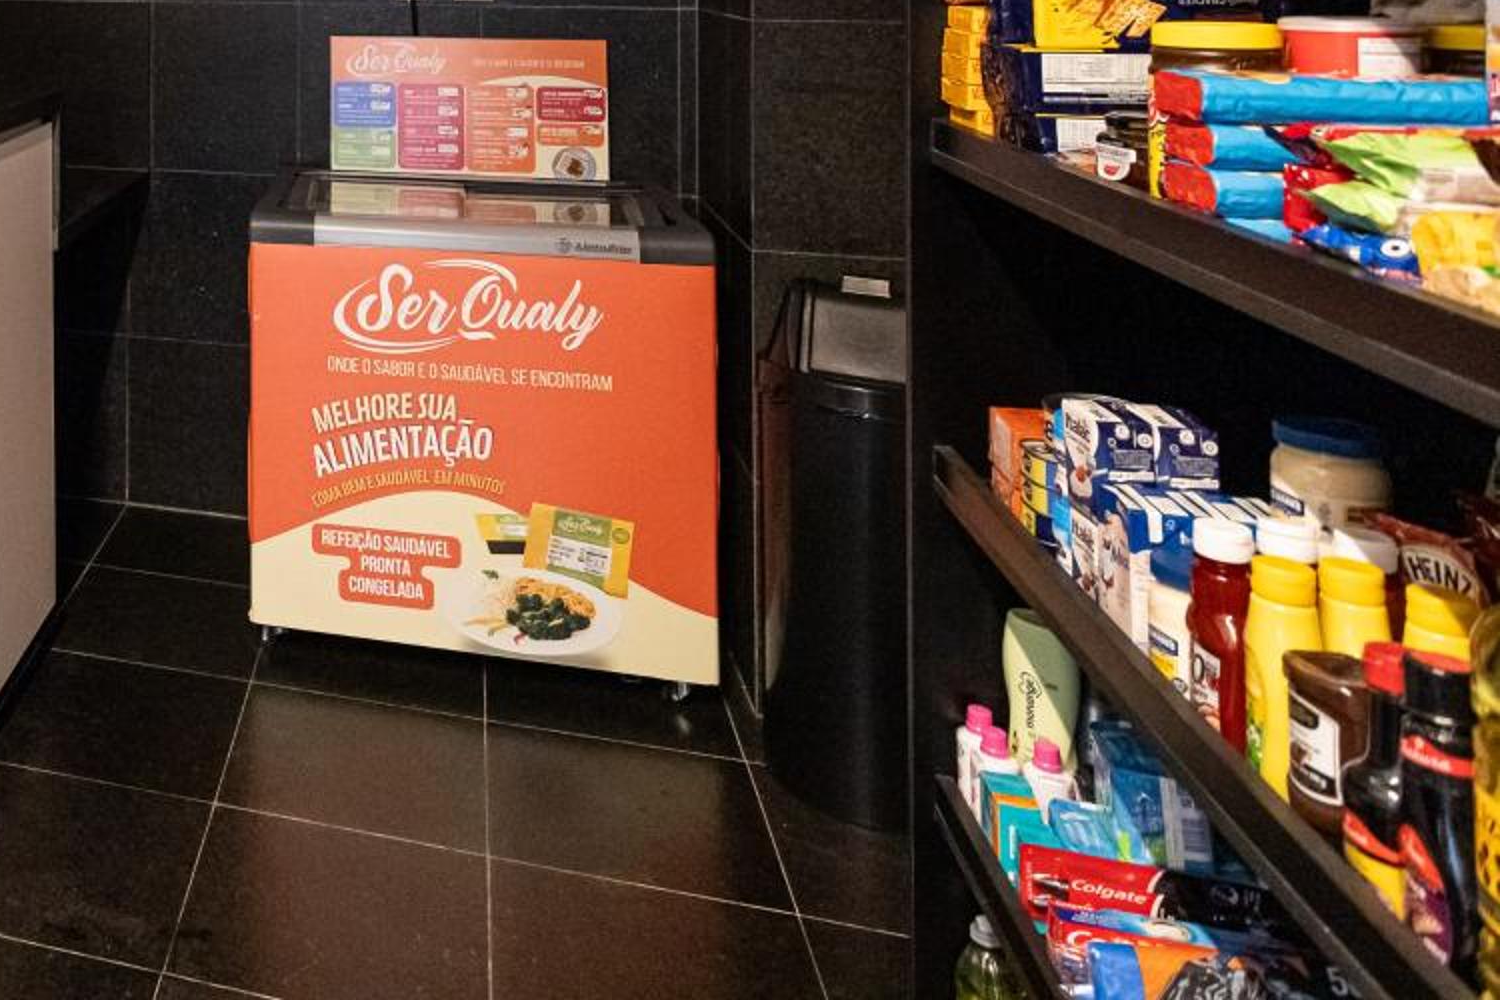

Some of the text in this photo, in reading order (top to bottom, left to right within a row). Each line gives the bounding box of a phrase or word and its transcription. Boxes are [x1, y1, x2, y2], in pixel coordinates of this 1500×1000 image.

[356, 264, 604, 351] Ser Qualy
[327, 356, 613, 392] ONDE O SABOR E O SAUDÁVEL SE ENCONTRAM
[311, 393, 457, 434] MELHORE SUA
[312, 418, 493, 477] ALIMENTAÇÃO
[311, 487, 343, 508] COMA
[342, 479, 366, 496] BEM
[434, 470, 453, 485] EM
[453, 471, 505, 494] MINUTOS
[320, 528, 452, 559] REFEIÇÃO SAUDÁVEL
[360, 555, 411, 576] PRONTA
[1406, 555, 1472, 593] HEINZ
[349, 575, 424, 600] CONGELADA
[1070, 877, 1149, 905] Colgate
